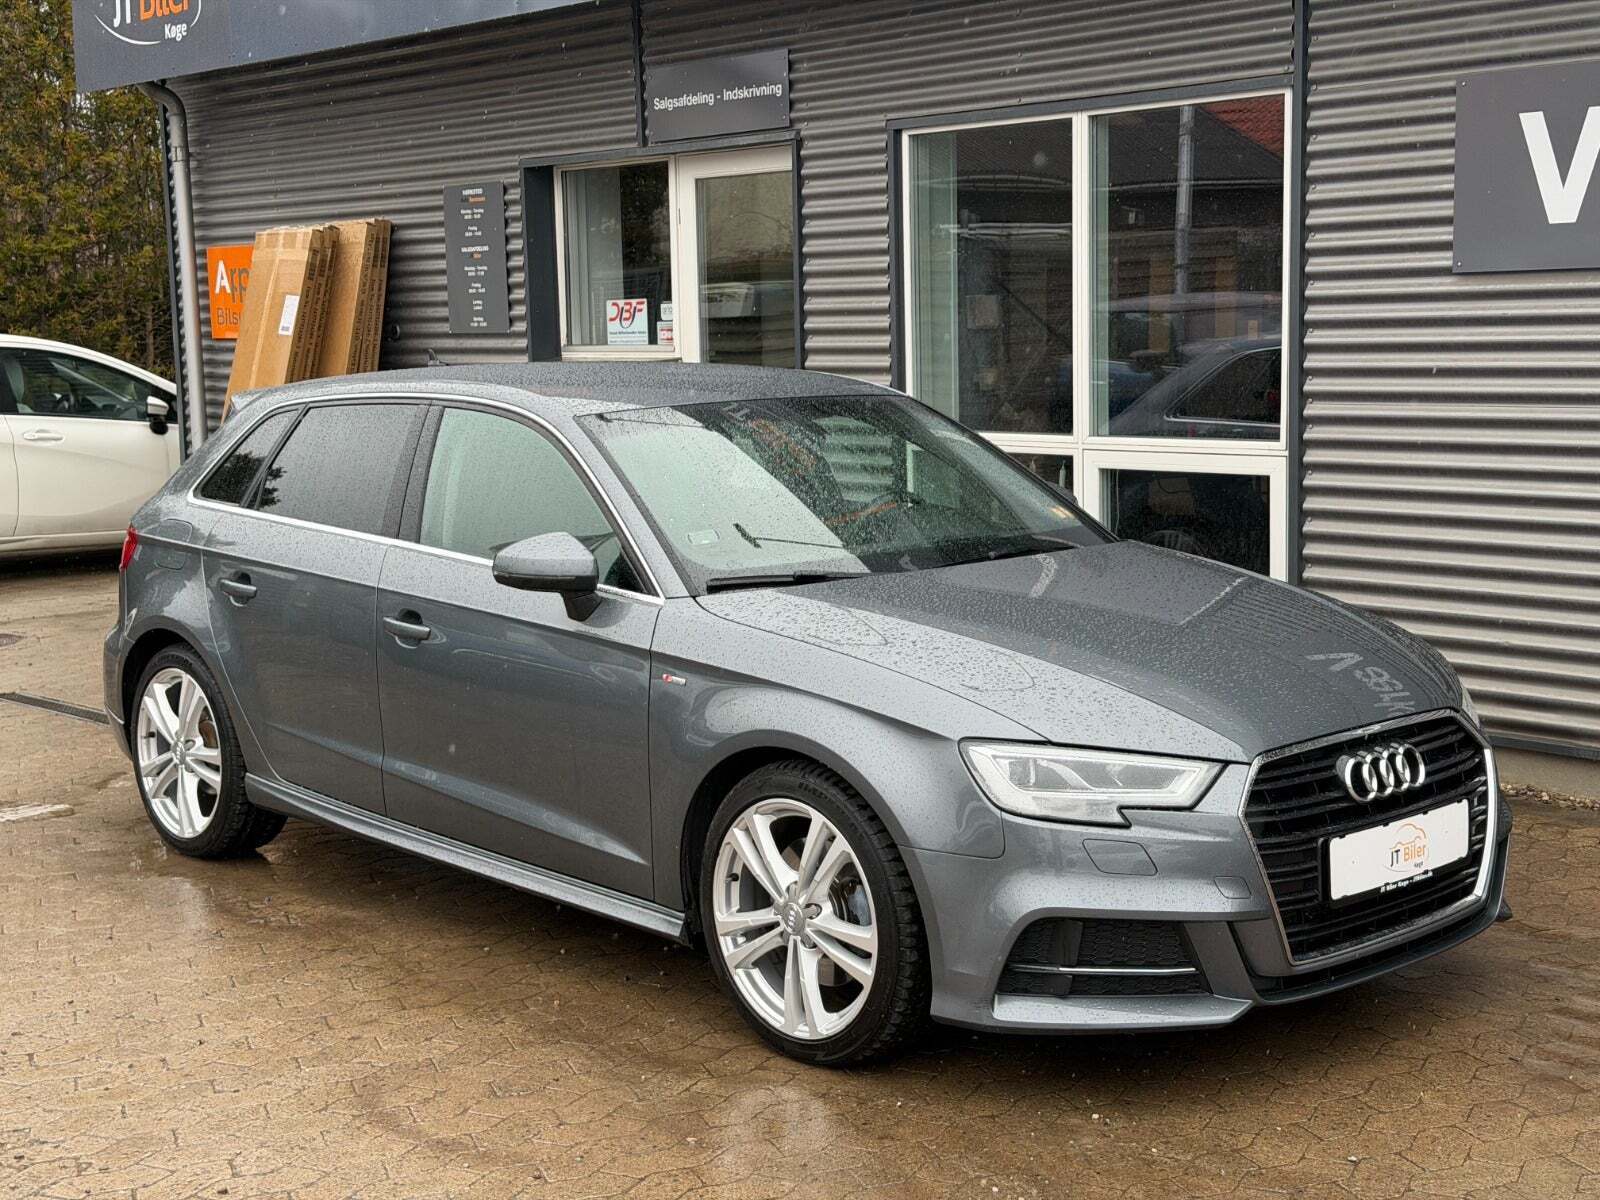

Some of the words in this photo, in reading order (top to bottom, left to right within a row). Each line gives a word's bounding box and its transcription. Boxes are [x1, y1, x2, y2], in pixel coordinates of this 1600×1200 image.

[164, 22, 188, 41] Køge
[653, 92, 715, 111] Salgsafdeling
[722, 82, 783, 101] Indskrivning
[1403, 843, 1425, 862] Biler
